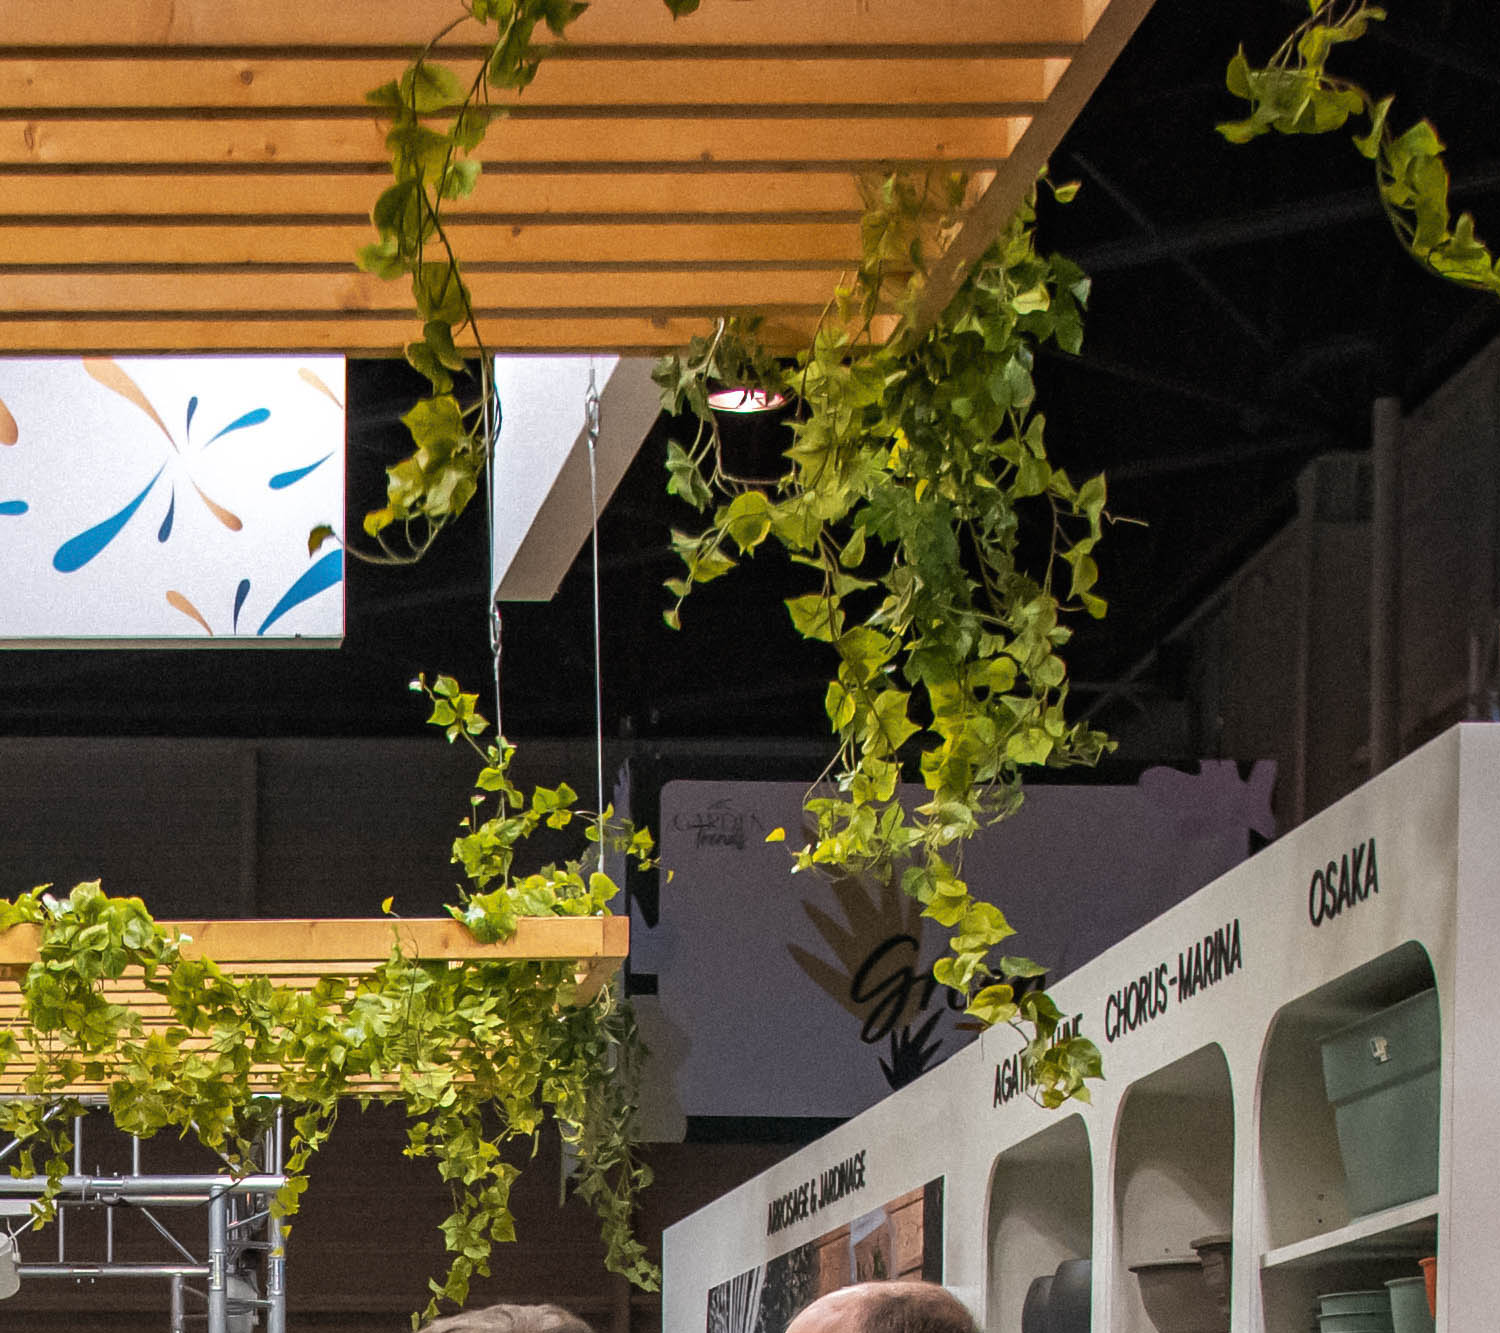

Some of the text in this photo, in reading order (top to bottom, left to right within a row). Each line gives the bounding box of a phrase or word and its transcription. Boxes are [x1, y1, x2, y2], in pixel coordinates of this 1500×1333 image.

[1308, 837, 1379, 928] OSAKA
[1104, 917, 1243, 1043] CHORUS-MARINA
[818, 1149, 866, 1210] JARDINAGE
